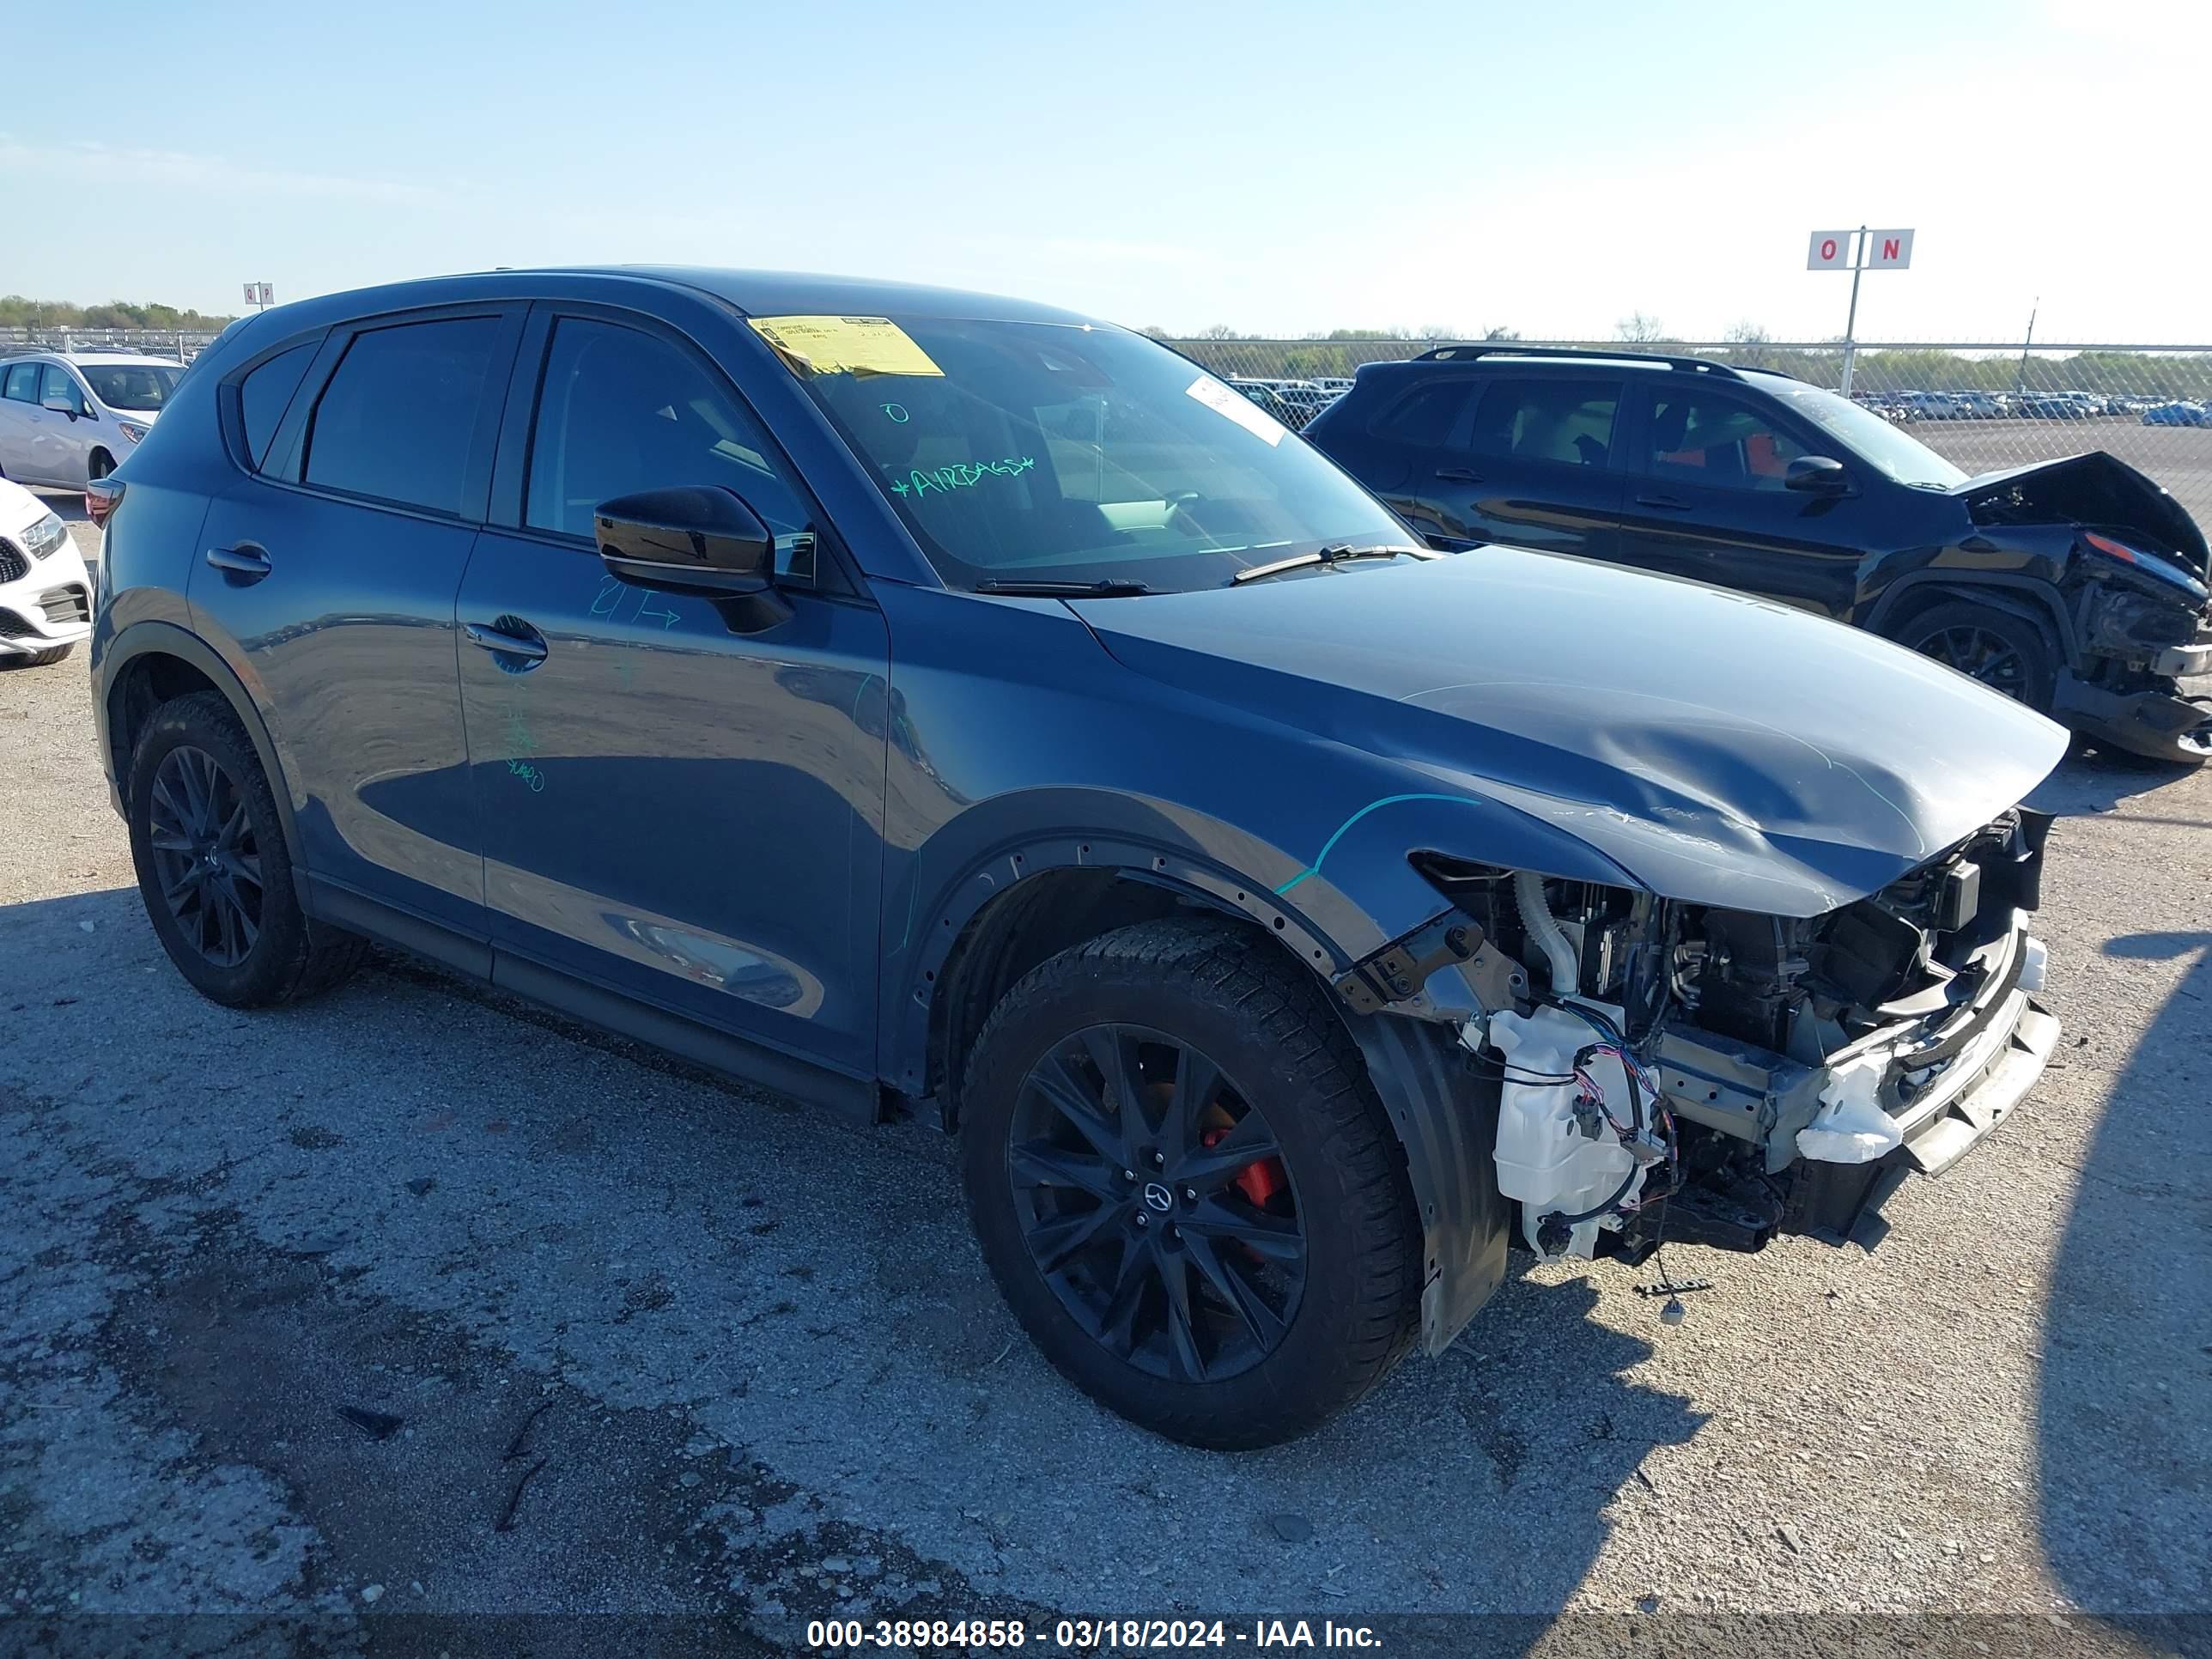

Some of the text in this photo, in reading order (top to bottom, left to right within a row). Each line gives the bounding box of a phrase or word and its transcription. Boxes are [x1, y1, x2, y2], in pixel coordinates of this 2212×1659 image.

[1820, 239, 1837, 260] O
[1883, 239, 1900, 260] N
[246, 288, 253, 301] Q
[264, 288, 270, 300] P
